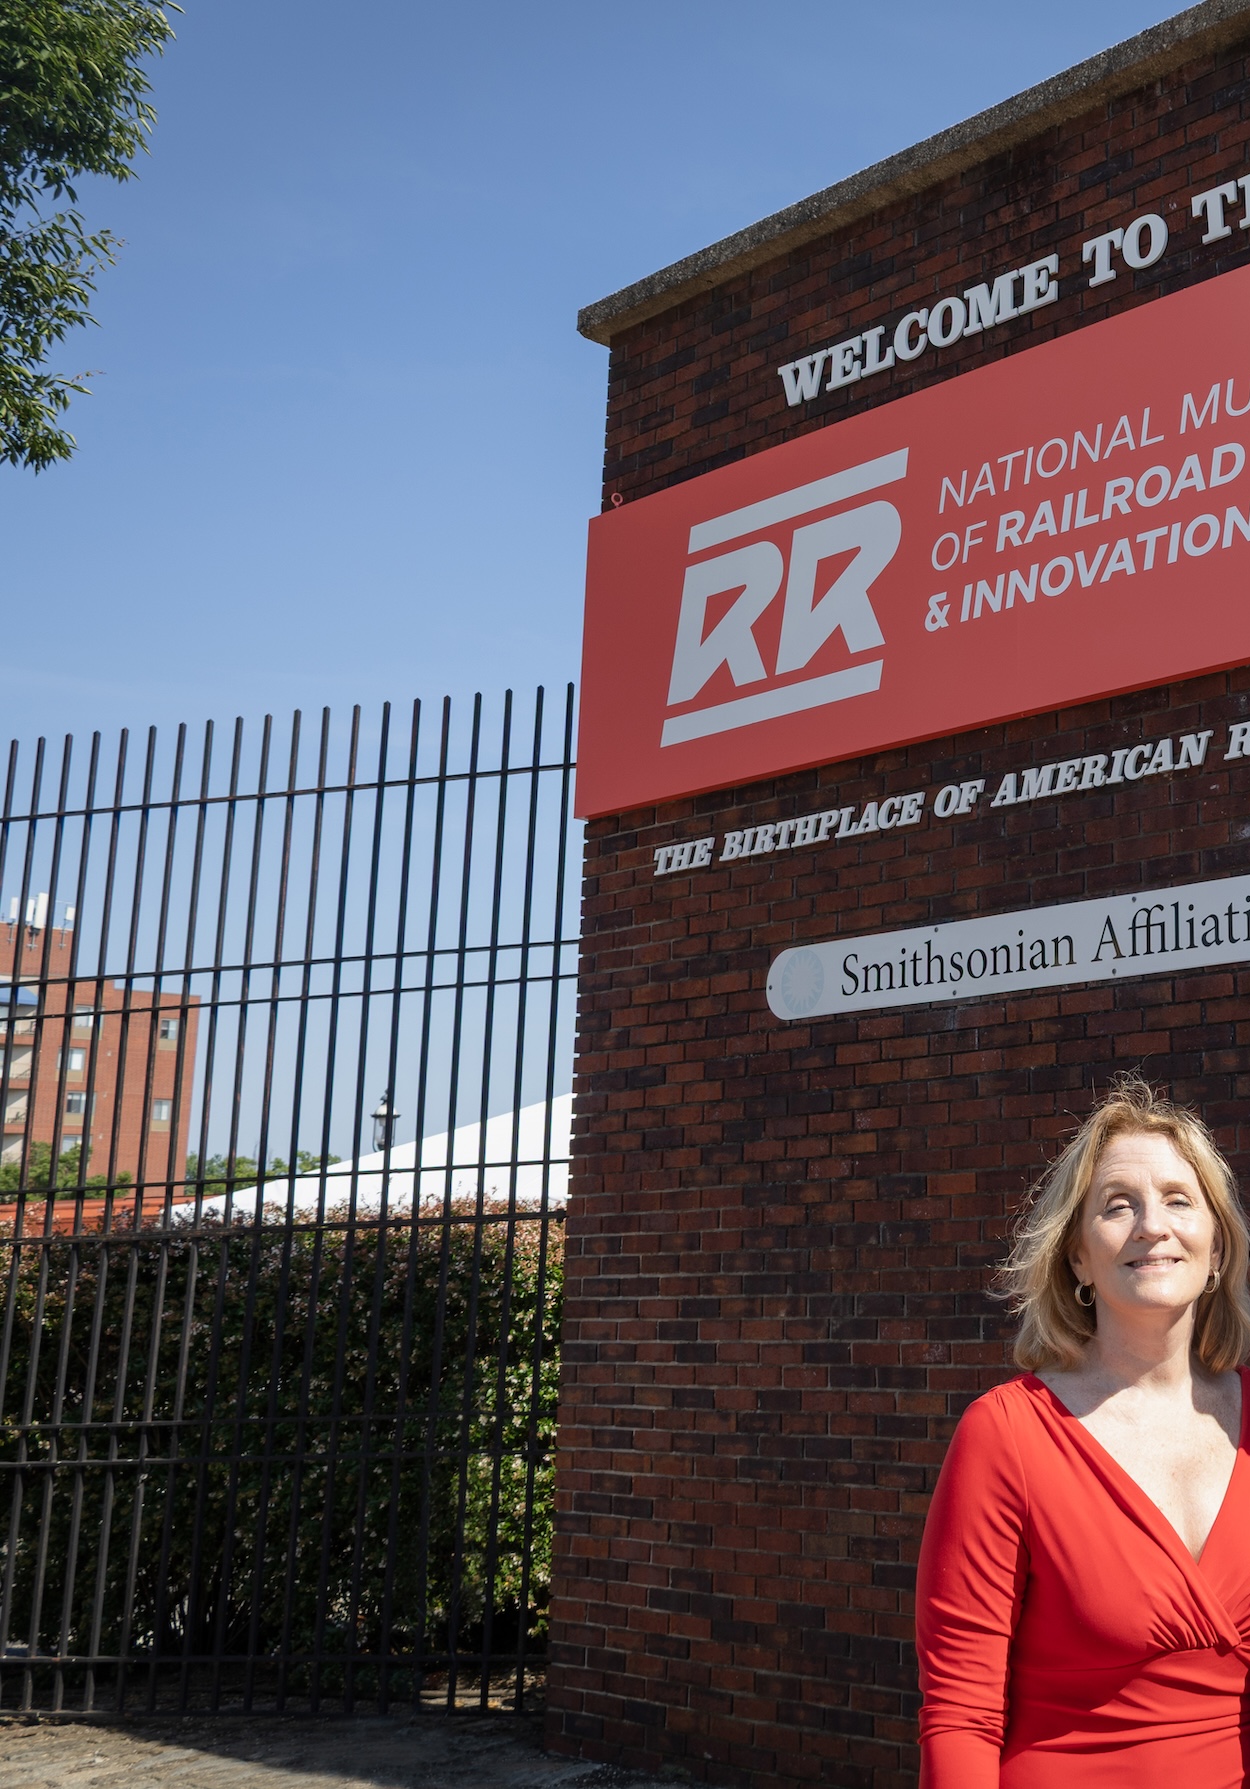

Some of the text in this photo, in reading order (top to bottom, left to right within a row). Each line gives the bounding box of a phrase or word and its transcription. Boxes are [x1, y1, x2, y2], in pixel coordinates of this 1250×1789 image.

[777, 254, 1059, 407] WELCOME
[1083, 213, 1168, 288] TO
[931, 520, 988, 571] OF
[995, 442, 1246, 553] RAILROAD
[938, 405, 1165, 513] NATIONAL
[666, 499, 904, 707] RR
[924, 591, 951, 633] &
[653, 837, 715, 876] THE
[719, 791, 923, 862] BIRTHPLACE
[933, 779, 984, 818] OF
[990, 730, 1213, 808] AMERICAN
[840, 932, 1076, 997] Smithsonian
